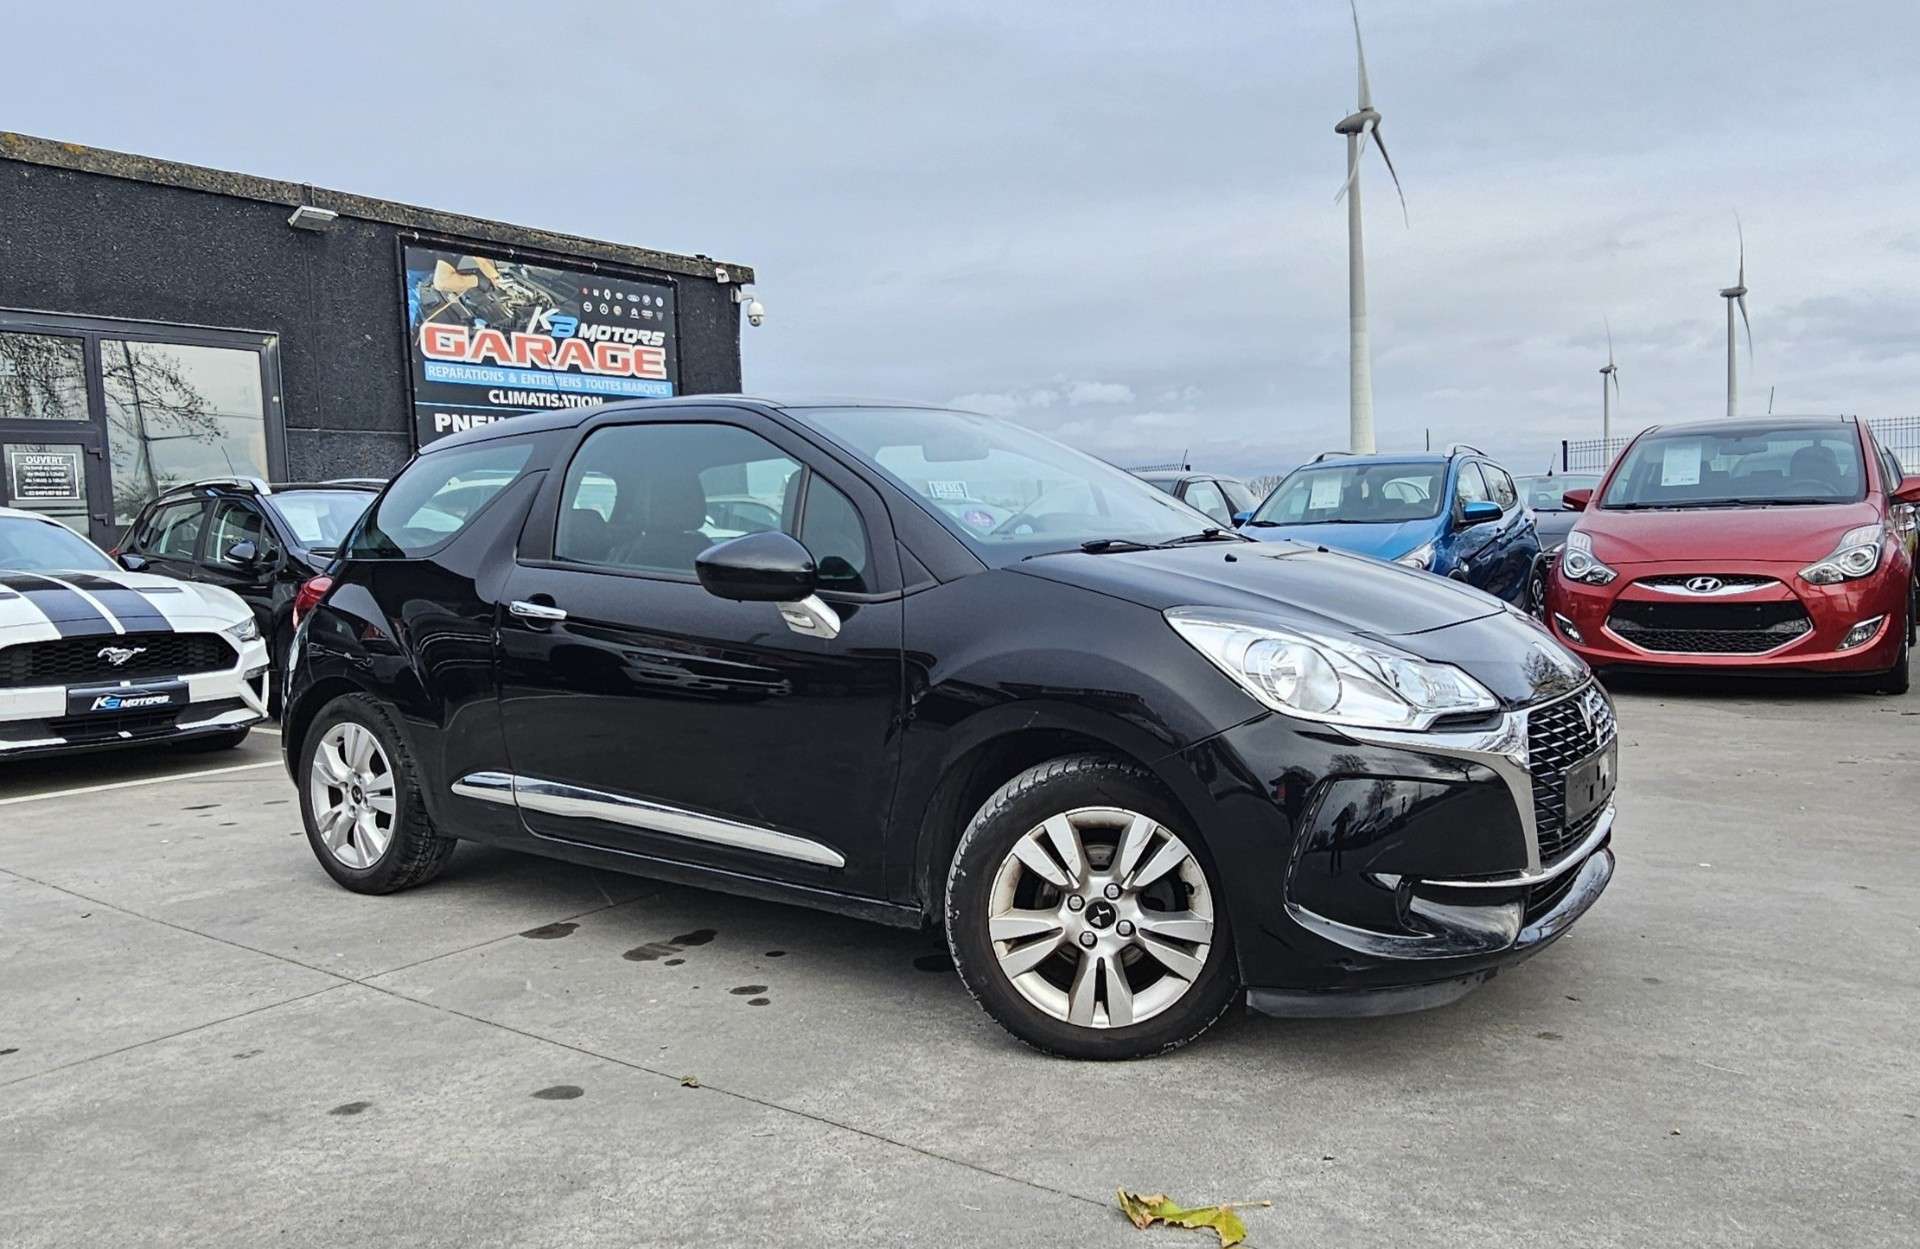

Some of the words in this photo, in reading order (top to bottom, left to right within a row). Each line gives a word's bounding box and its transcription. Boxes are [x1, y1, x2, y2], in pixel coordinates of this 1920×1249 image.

[526, 306, 579, 339] KB
[578, 323, 665, 346] MOTORS
[420, 323, 667, 380] GARAGE
[428, 366, 505, 382] REPARATIONS
[508, 372, 518, 383] &
[585, 378, 621, 391] TOUTES
[622, 382, 667, 395] MARQUES
[488, 389, 603, 408] CLIMATISATION
[25, 455, 63, 464] OUVERT
[120, 695, 170, 708] MOTORS
